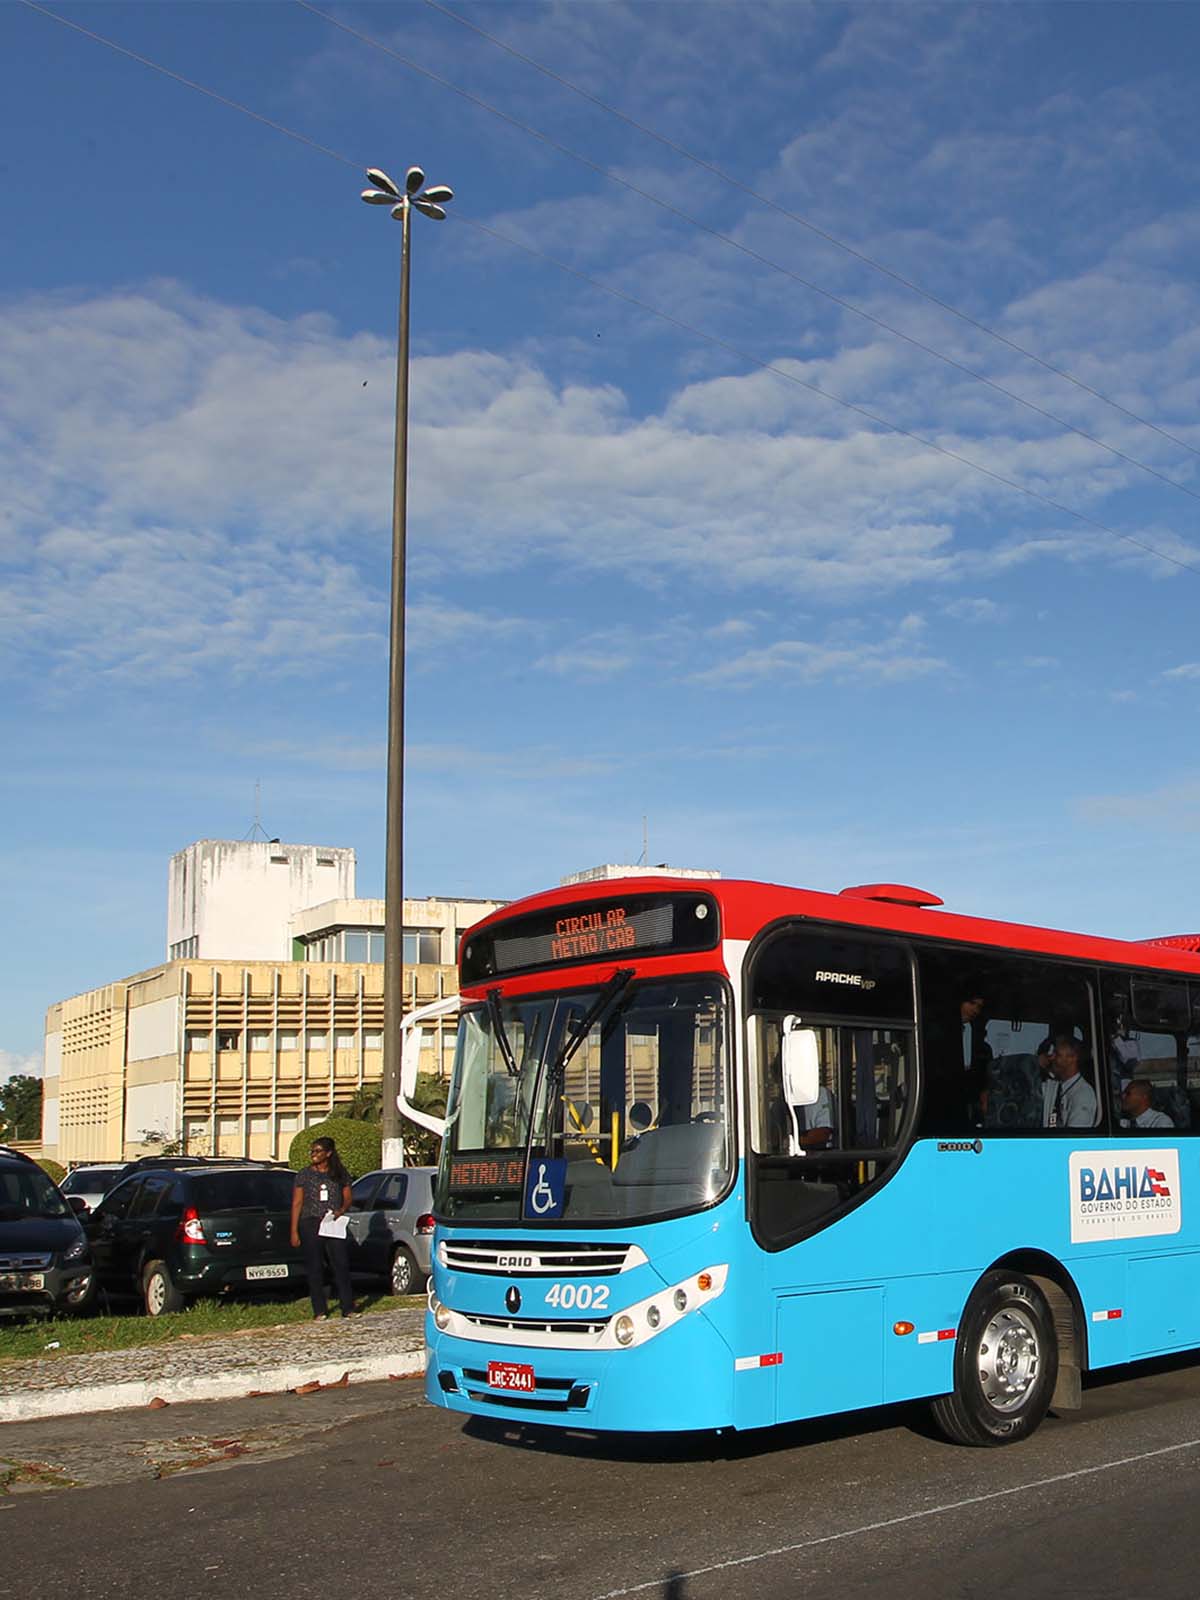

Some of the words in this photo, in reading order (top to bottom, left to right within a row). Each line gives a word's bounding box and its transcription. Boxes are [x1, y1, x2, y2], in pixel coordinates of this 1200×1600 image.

[556, 908, 626, 937] CIRCULAR
[815, 970, 862, 986] APACHE
[1080, 1166, 1157, 1202] BAHIA
[1080, 1201, 1123, 1213] GOVERNO
[1126, 1200, 1138, 1210] DO
[1141, 1198, 1172, 1209] ESTADO
[499, 1256, 532, 1267] CAIO
[544, 1283, 611, 1310] 4002
